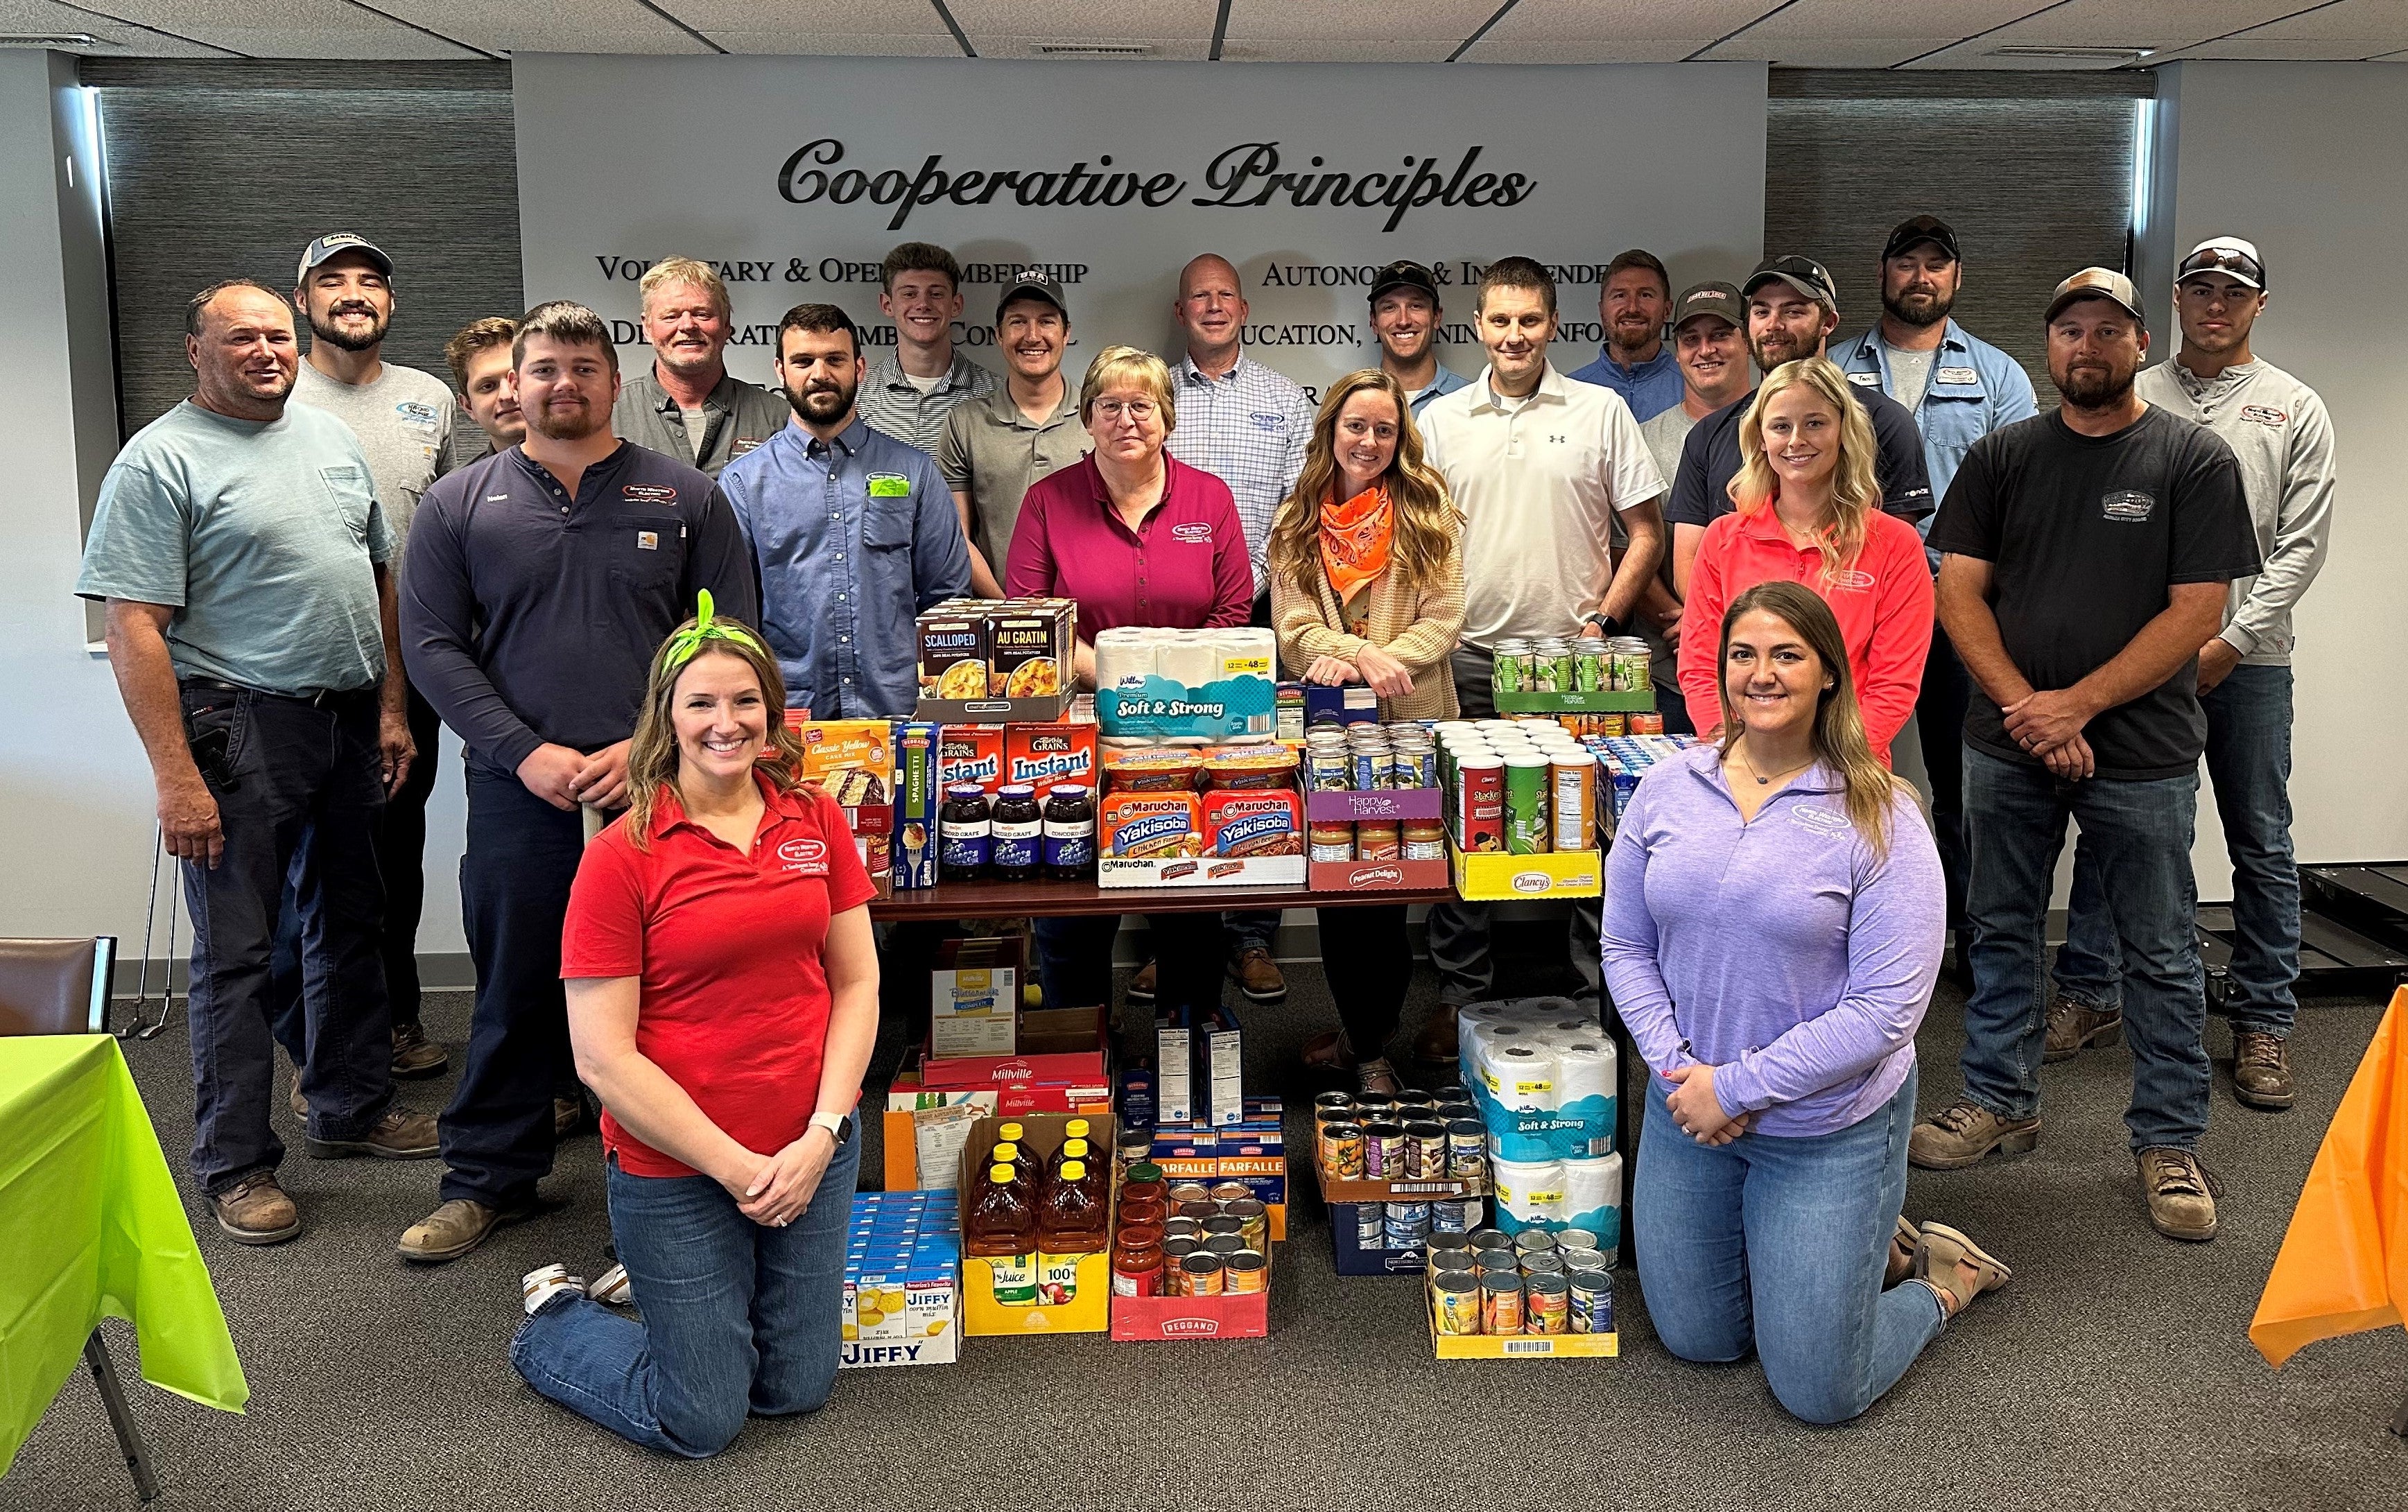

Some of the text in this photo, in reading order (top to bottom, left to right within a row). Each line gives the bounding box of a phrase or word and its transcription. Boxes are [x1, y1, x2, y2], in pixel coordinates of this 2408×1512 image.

[778, 139, 1536, 232] Cooperative Principles
[784, 258, 811, 282] &
[1262, 262, 1384, 286] AUTONO
[1434, 262, 1453, 285] &
[1240, 324, 1362, 349] UCATION,
[487, 493, 508, 503] Nolan
[925, 633, 976, 648] SCALLOPED
[997, 631, 1047, 645] AU GRATIN
[1248, 660, 1259, 668] 48
[1117, 701, 1224, 718] Soft & Strong
[811, 739, 870, 755] Classic Yellow
[1033, 740, 1068, 751] GRAINS
[942, 756, 996, 782] stant
[1014, 749, 1089, 780] Instant
[912, 755, 920, 803] SPAGHETTI
[1132, 801, 1188, 812] Maruchan
[1236, 801, 1288, 811] Maruchan
[1349, 795, 1384, 807] Happy
[1353, 805, 1396, 815] Harvest
[1118, 817, 1188, 844] Yakisoba
[1222, 815, 1289, 843] Yakisoba
[1132, 839, 1161, 855] Chicken
[1353, 869, 1398, 884] Peanut Delight
[1514, 875, 1551, 889] Clancy's
[991, 1068, 1032, 1080] Millville
[1005, 1098, 1034, 1107] Millville
[1518, 1119, 1584, 1131] Soft & Strong
[1159, 1163, 1216, 1173] ARFALLE
[1220, 1162, 1283, 1172] FARFALLE
[1000, 1270, 1025, 1283] Juice
[1166, 1321, 1214, 1333] REGGANO
